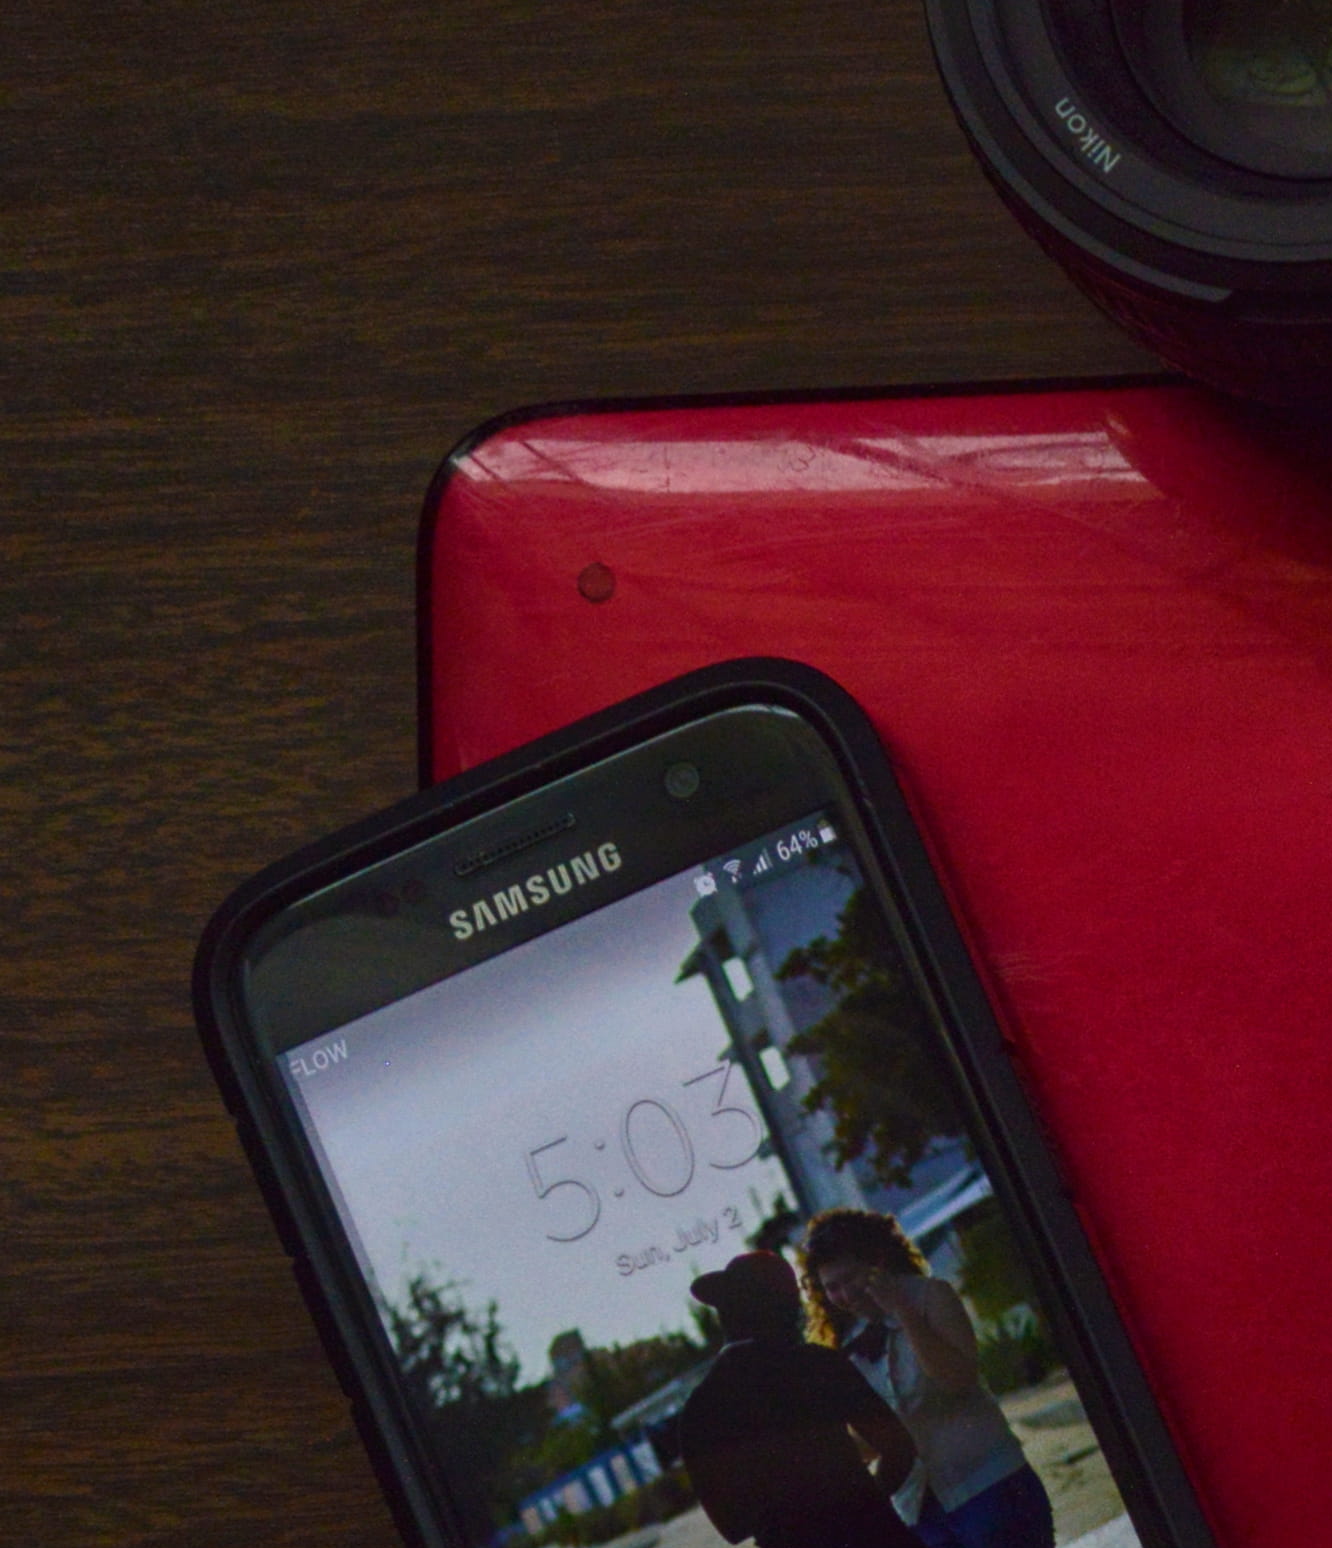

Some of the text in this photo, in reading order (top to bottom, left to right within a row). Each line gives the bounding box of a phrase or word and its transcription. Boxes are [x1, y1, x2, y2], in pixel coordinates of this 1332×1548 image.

[1055, 97, 1121, 173] Nikon
[775, 828, 819, 863] 64%
[448, 841, 624, 941] SAMSUNG
[289, 1039, 349, 1077] FLOW
[527, 1059, 764, 1243] 5:03
[672, 1216, 720, 1253] July
[723, 1206, 743, 1230] 2
